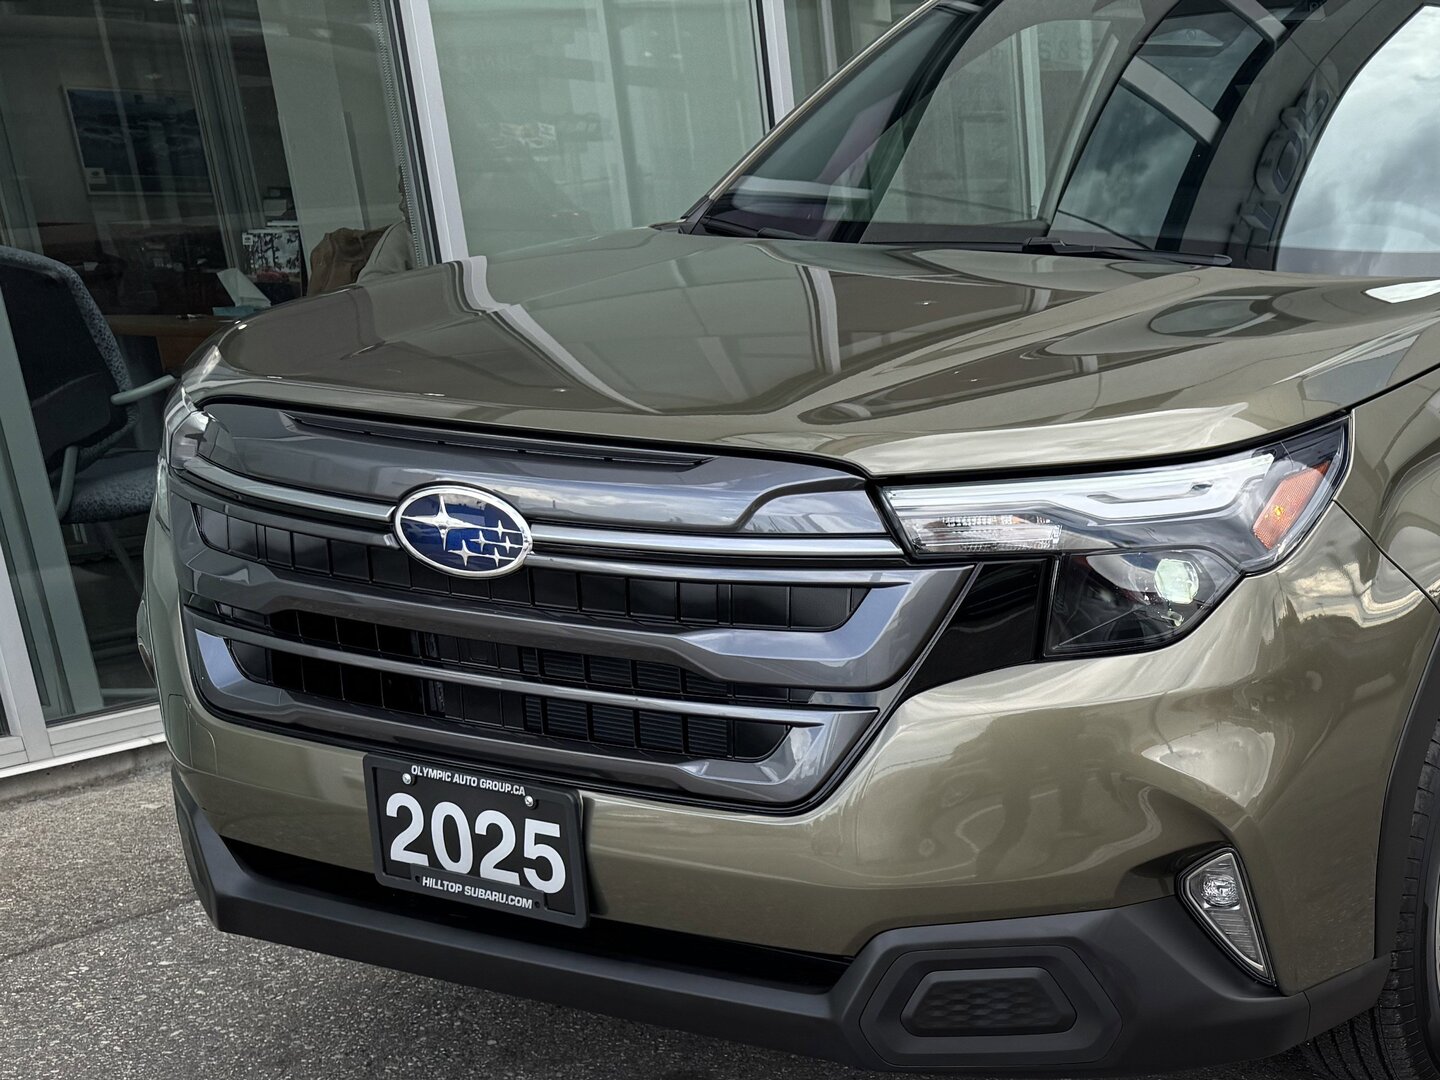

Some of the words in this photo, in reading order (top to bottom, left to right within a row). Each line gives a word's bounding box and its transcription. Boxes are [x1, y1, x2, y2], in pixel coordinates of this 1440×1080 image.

[411, 765, 452, 782] OLYMPIC
[453, 773, 478, 787] AUTO
[480, 778, 526, 796] GROUP.CA
[386, 792, 566, 894] 2025
[422, 876, 463, 893] HILLTOP
[464, 885, 533, 909] SUBARU.COM
